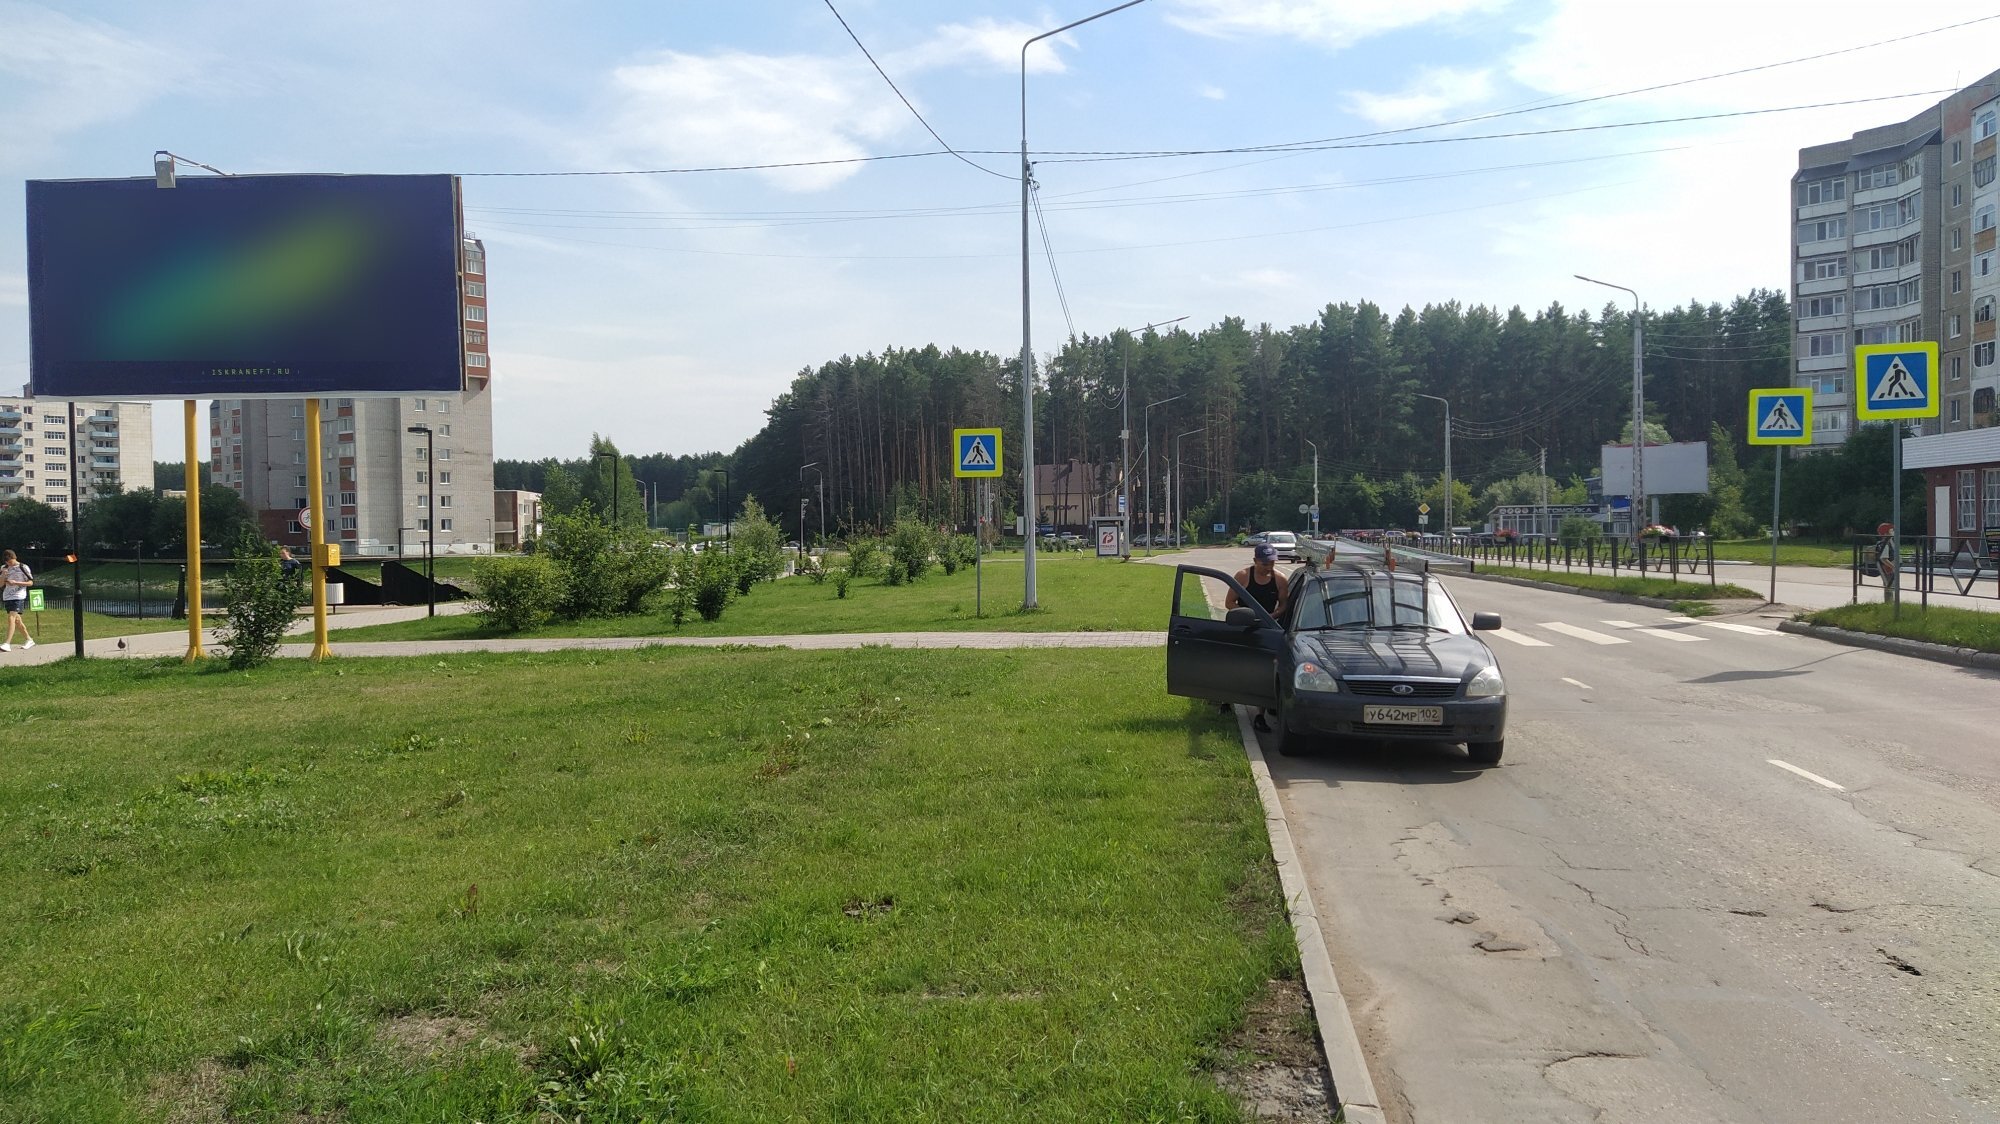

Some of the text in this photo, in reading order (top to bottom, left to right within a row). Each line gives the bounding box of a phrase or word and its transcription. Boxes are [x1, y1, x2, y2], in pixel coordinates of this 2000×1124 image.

[211, 368, 290, 376] ISKRANEFT.RU
[1369, 708, 1439, 721] У642МР 102
